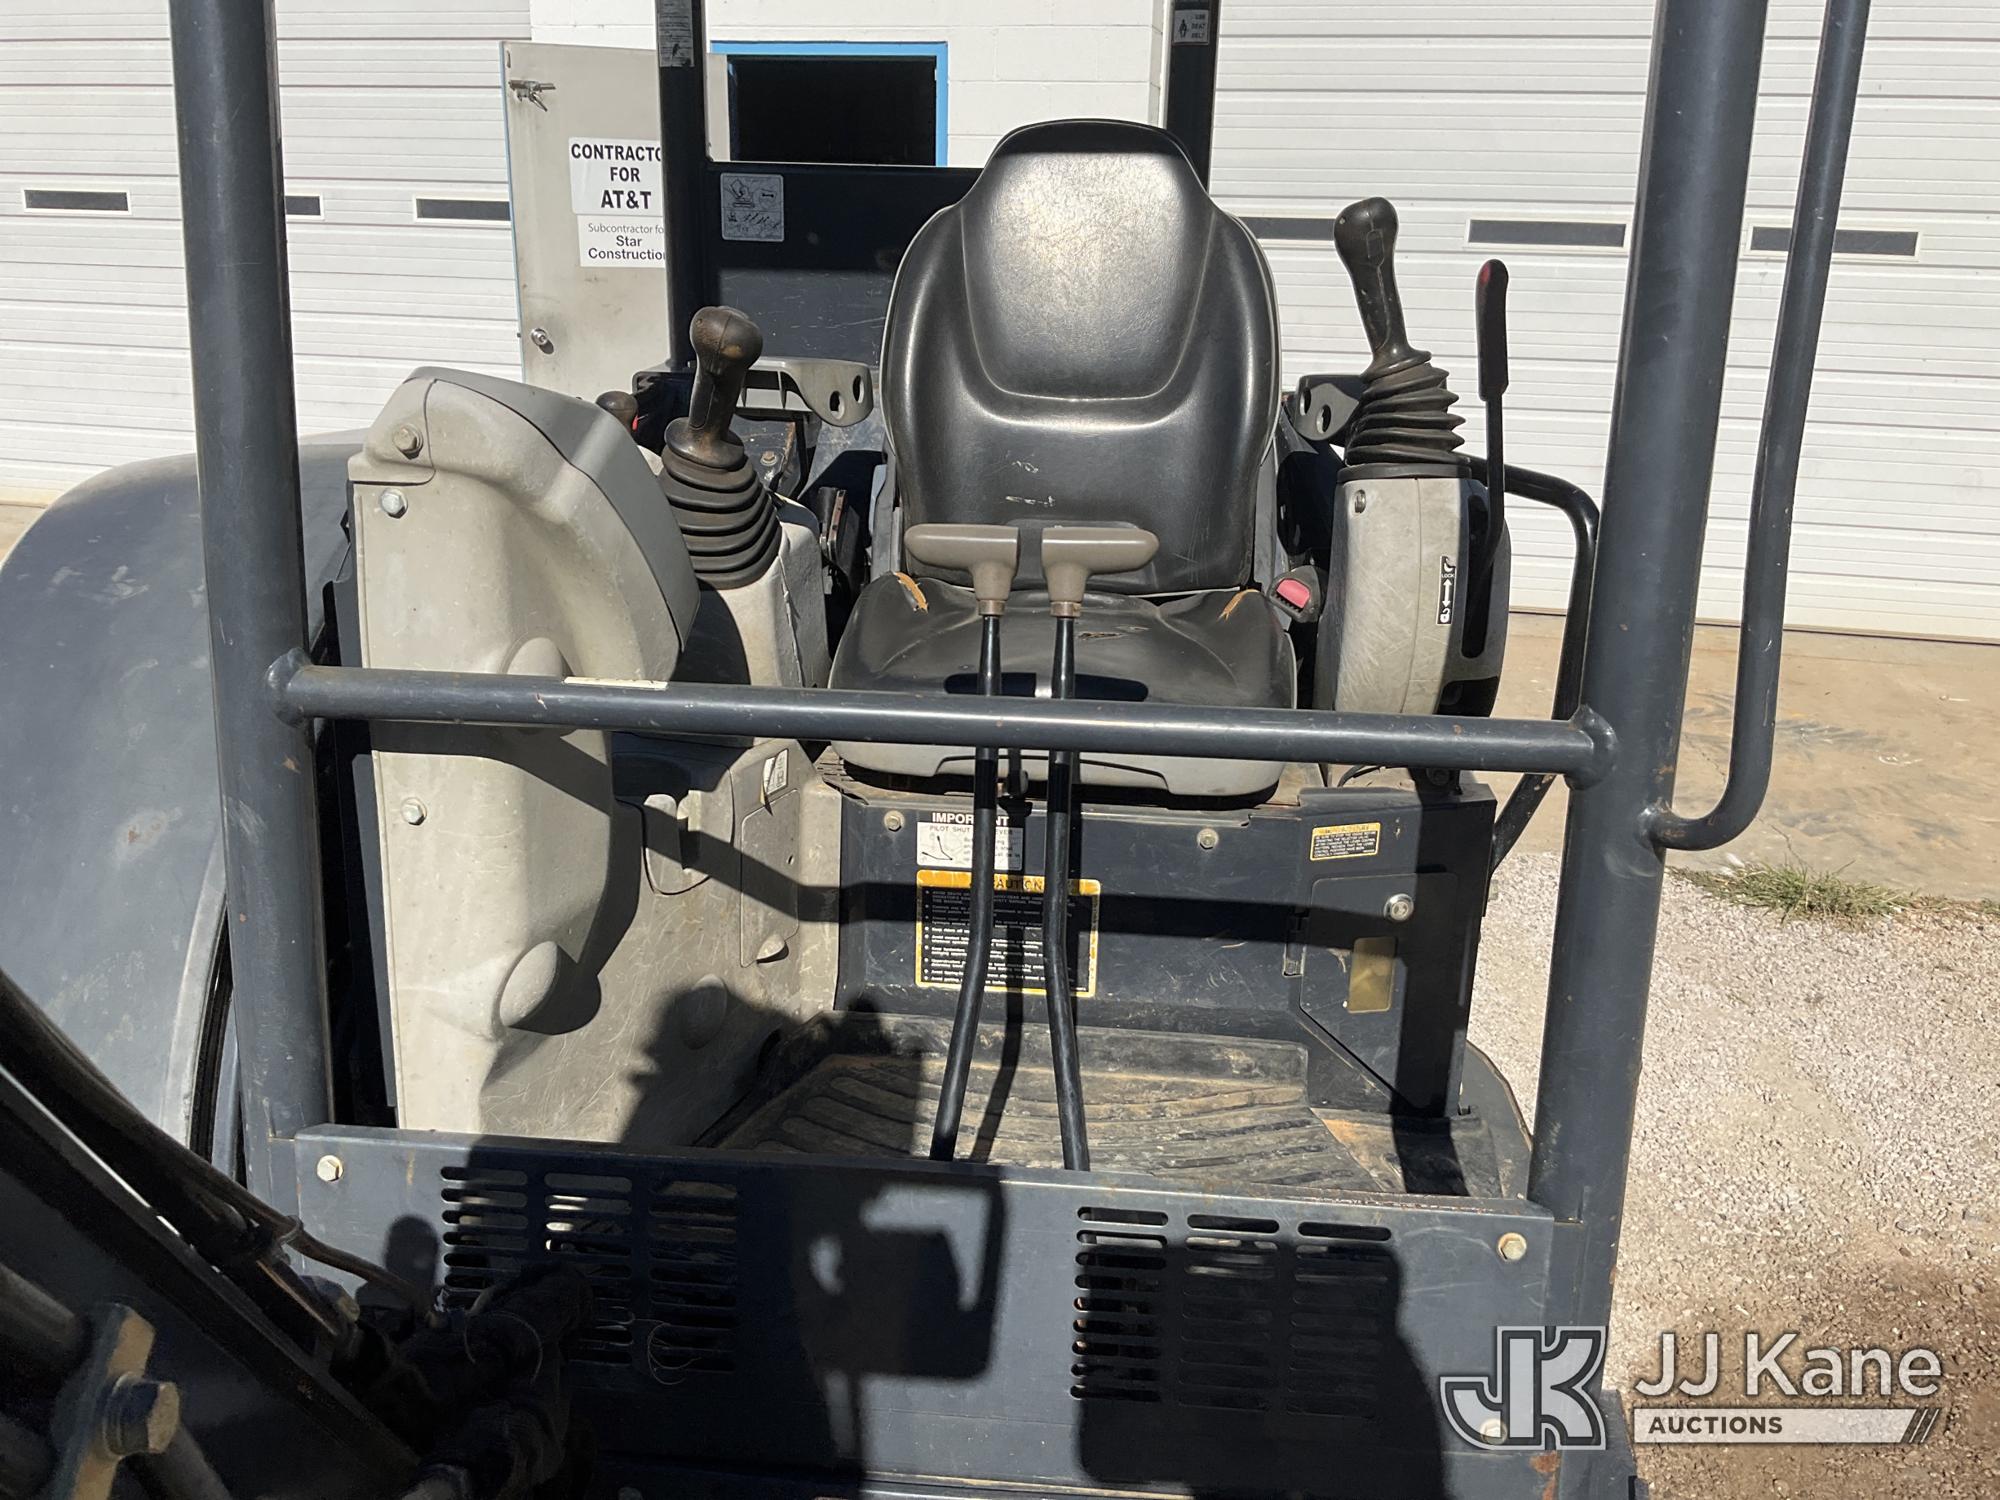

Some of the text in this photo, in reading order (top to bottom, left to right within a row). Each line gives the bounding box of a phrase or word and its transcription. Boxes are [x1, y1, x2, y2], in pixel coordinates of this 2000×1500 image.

[571, 143, 661, 162] CONTRACTO
[610, 166, 640, 182] FOR
[601, 189, 651, 209] AT&T
[588, 223, 665, 234] Subcontractor fo
[616, 235, 642, 247] Star
[588, 247, 666, 260] Constructio
[932, 812, 1009, 826] IMPORNT
